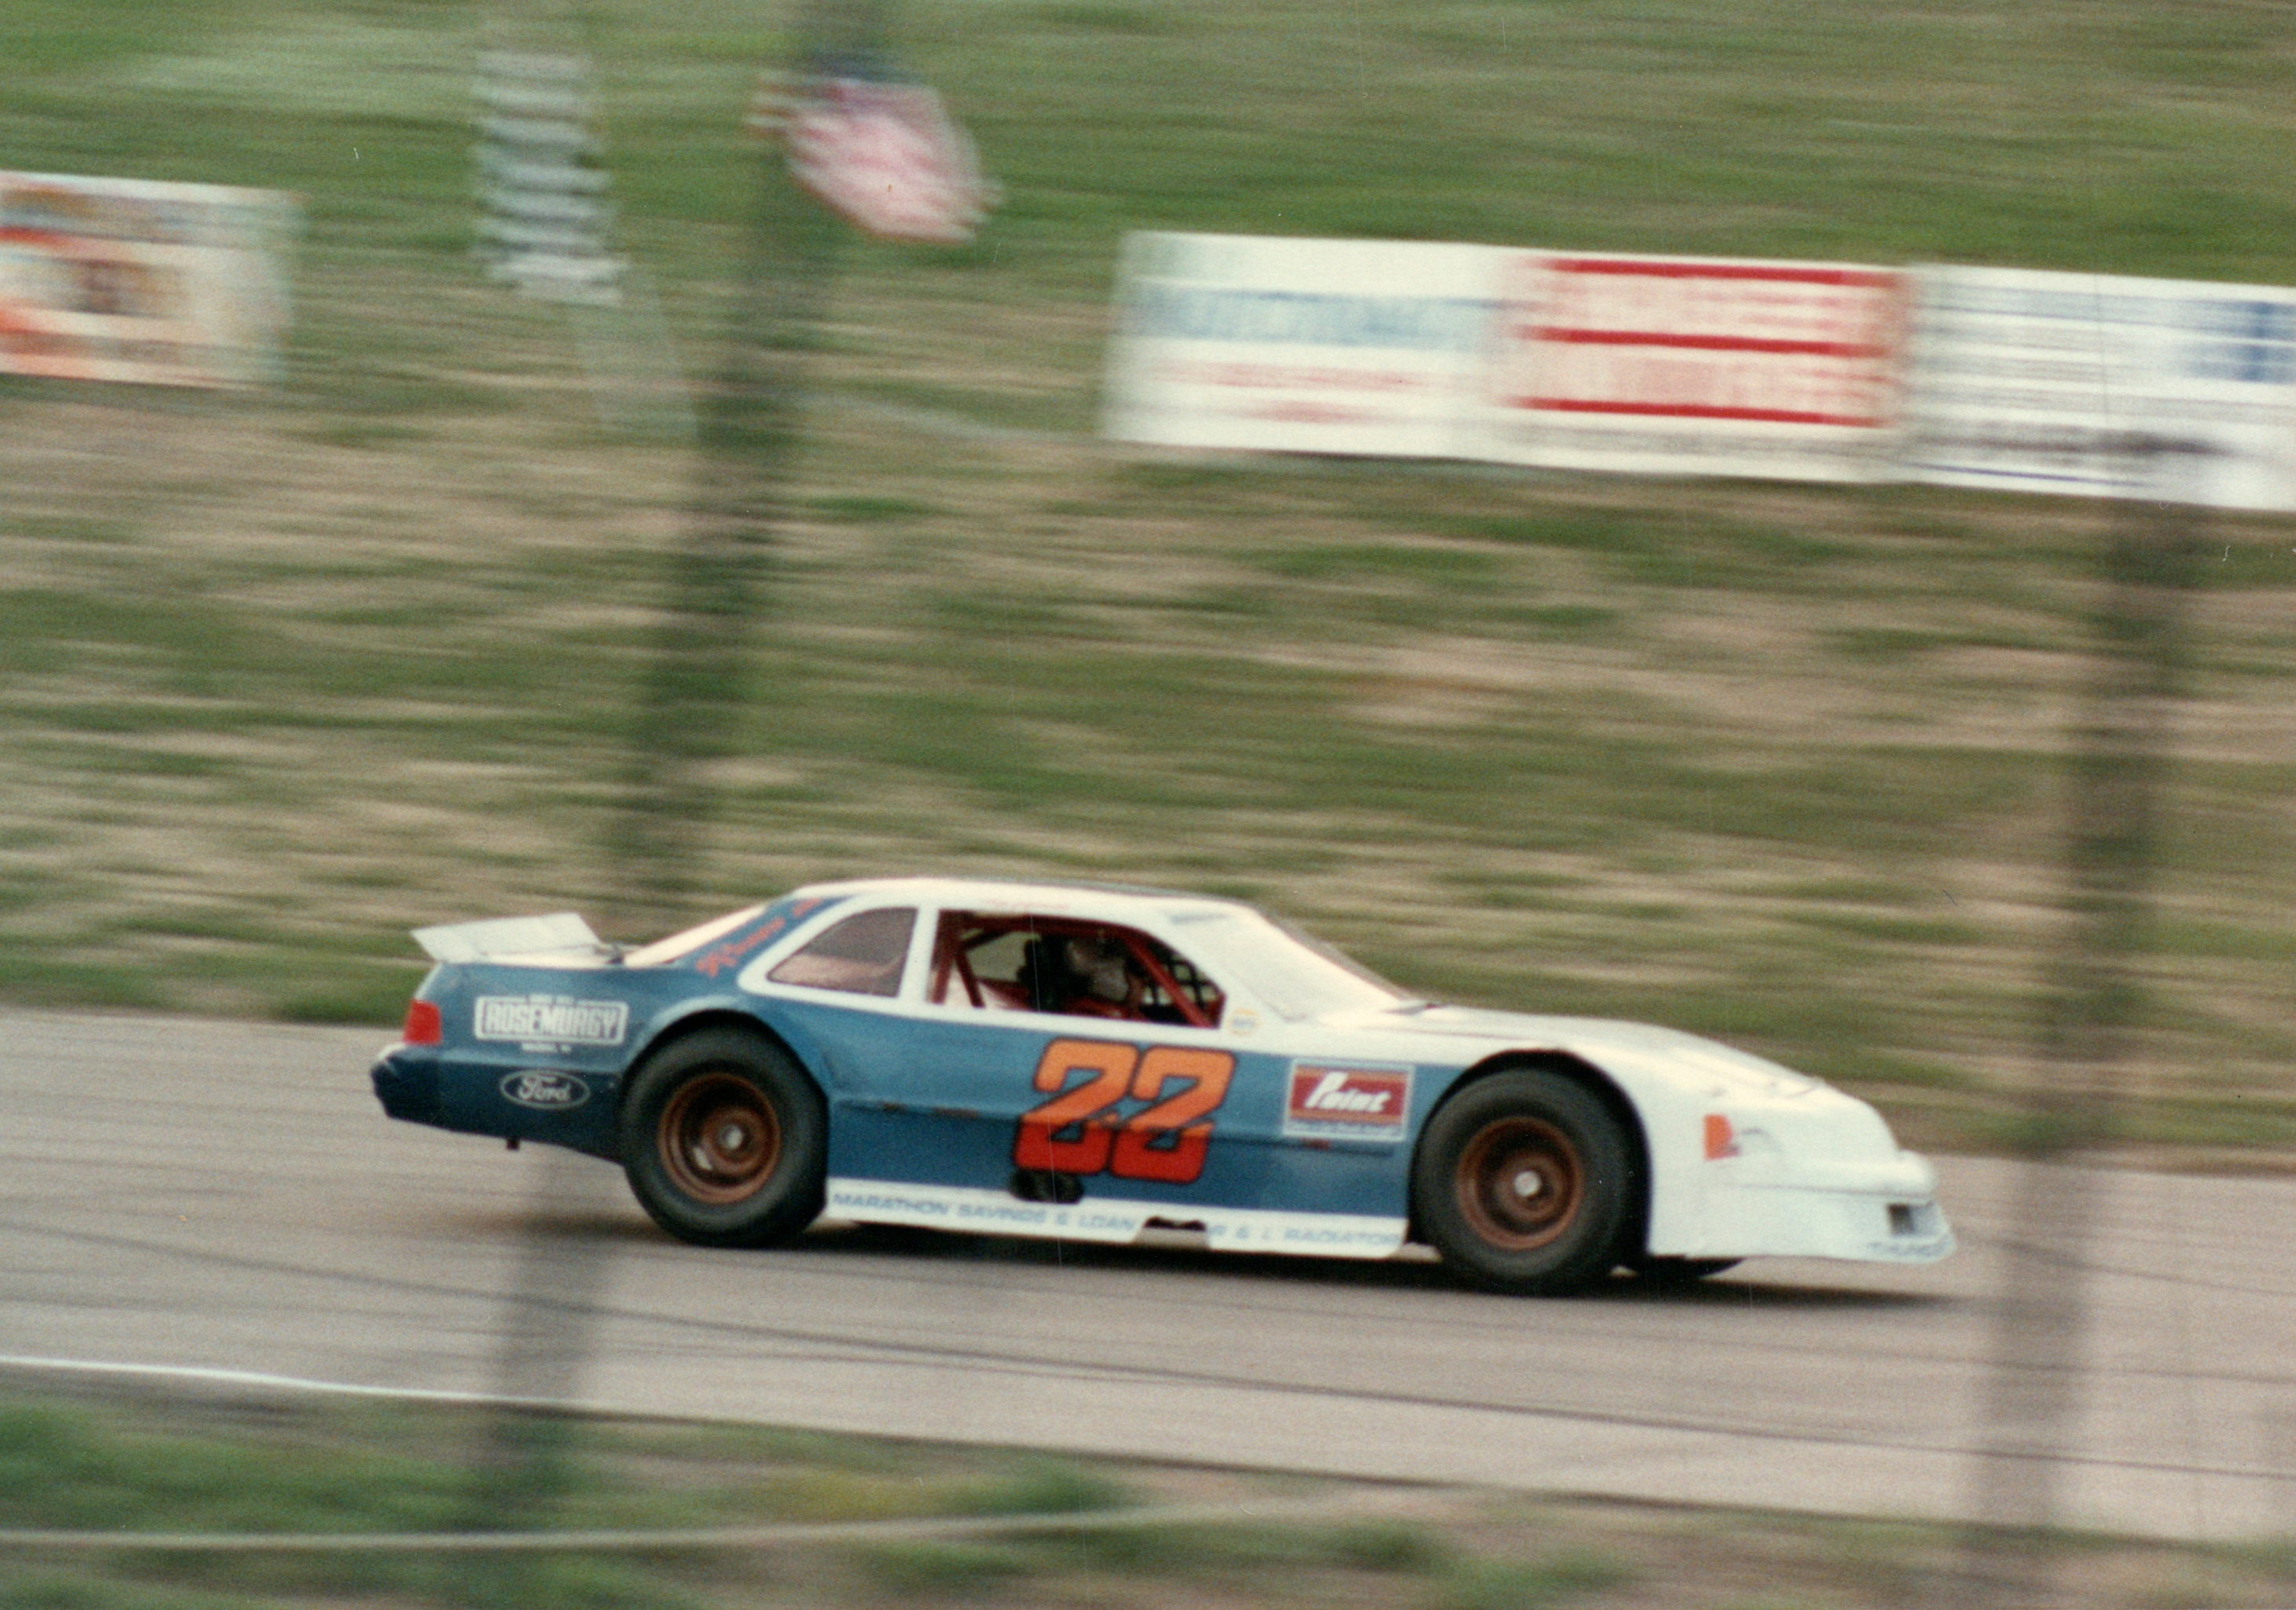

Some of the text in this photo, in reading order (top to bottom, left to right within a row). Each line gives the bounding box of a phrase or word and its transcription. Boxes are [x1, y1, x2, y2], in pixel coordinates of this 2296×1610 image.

[485, 1002, 618, 1039] ROSEMURGY
[517, 1076, 572, 1101] Ford
[1012, 1036, 1237, 1185] 22
[832, 1193, 949, 1215] MARATHON
[956, 1204, 1047, 1224] SAVINGS
[1079, 1215, 1135, 1231] LOAN
[1284, 1228, 1401, 1245] RADIATOR
